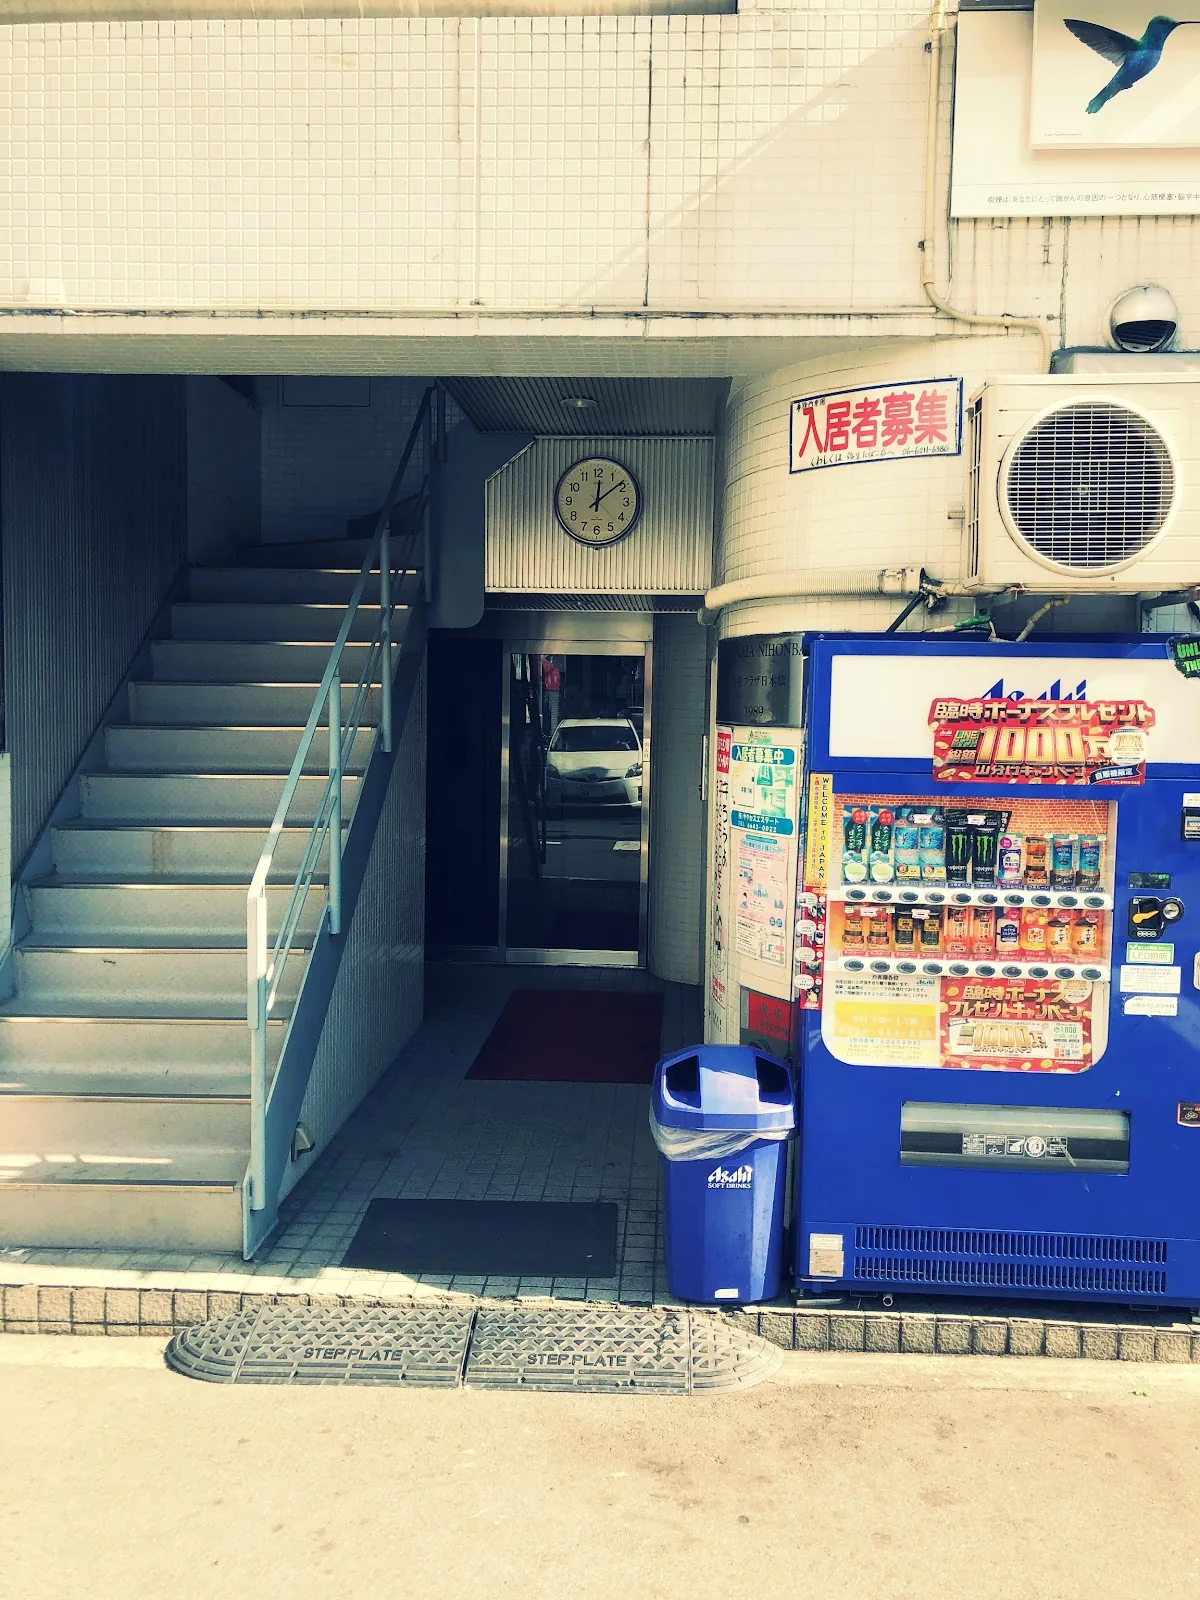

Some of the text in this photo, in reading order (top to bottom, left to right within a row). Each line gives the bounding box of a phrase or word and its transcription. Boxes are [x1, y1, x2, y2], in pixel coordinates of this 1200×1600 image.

[799, 389, 948, 458] 入居者募集
[581, 472, 588, 481] 11
[593, 468, 603, 478] 12
[610, 472, 614, 482] 1
[569, 482, 580, 492] 10
[619, 482, 626, 492] 2
[565, 496, 572, 506] 9
[622, 497, 630, 507] 3
[570, 511, 577, 521] 8
[617, 512, 624, 521] 4
[581, 522, 588, 531] 7
[593, 525, 600, 535] 6
[607, 522, 614, 531] 5
[745, 705, 764, 718] 1989
[933, 701, 1153, 723] 臨時ボーナスプレゼント
[955, 730, 978, 739] LINE
[736, 746, 784, 765] 入居者募集中
[973, 765, 1086, 779] 山分けキャンペーン
[818, 777, 830, 879] WELCOME TO JAPAN
[963, 985, 1068, 1003] 臨時ボーナス
[949, 1001, 1084, 1020] プレゼントキャンペーン
[707, 1165, 753, 1183] Asahi
